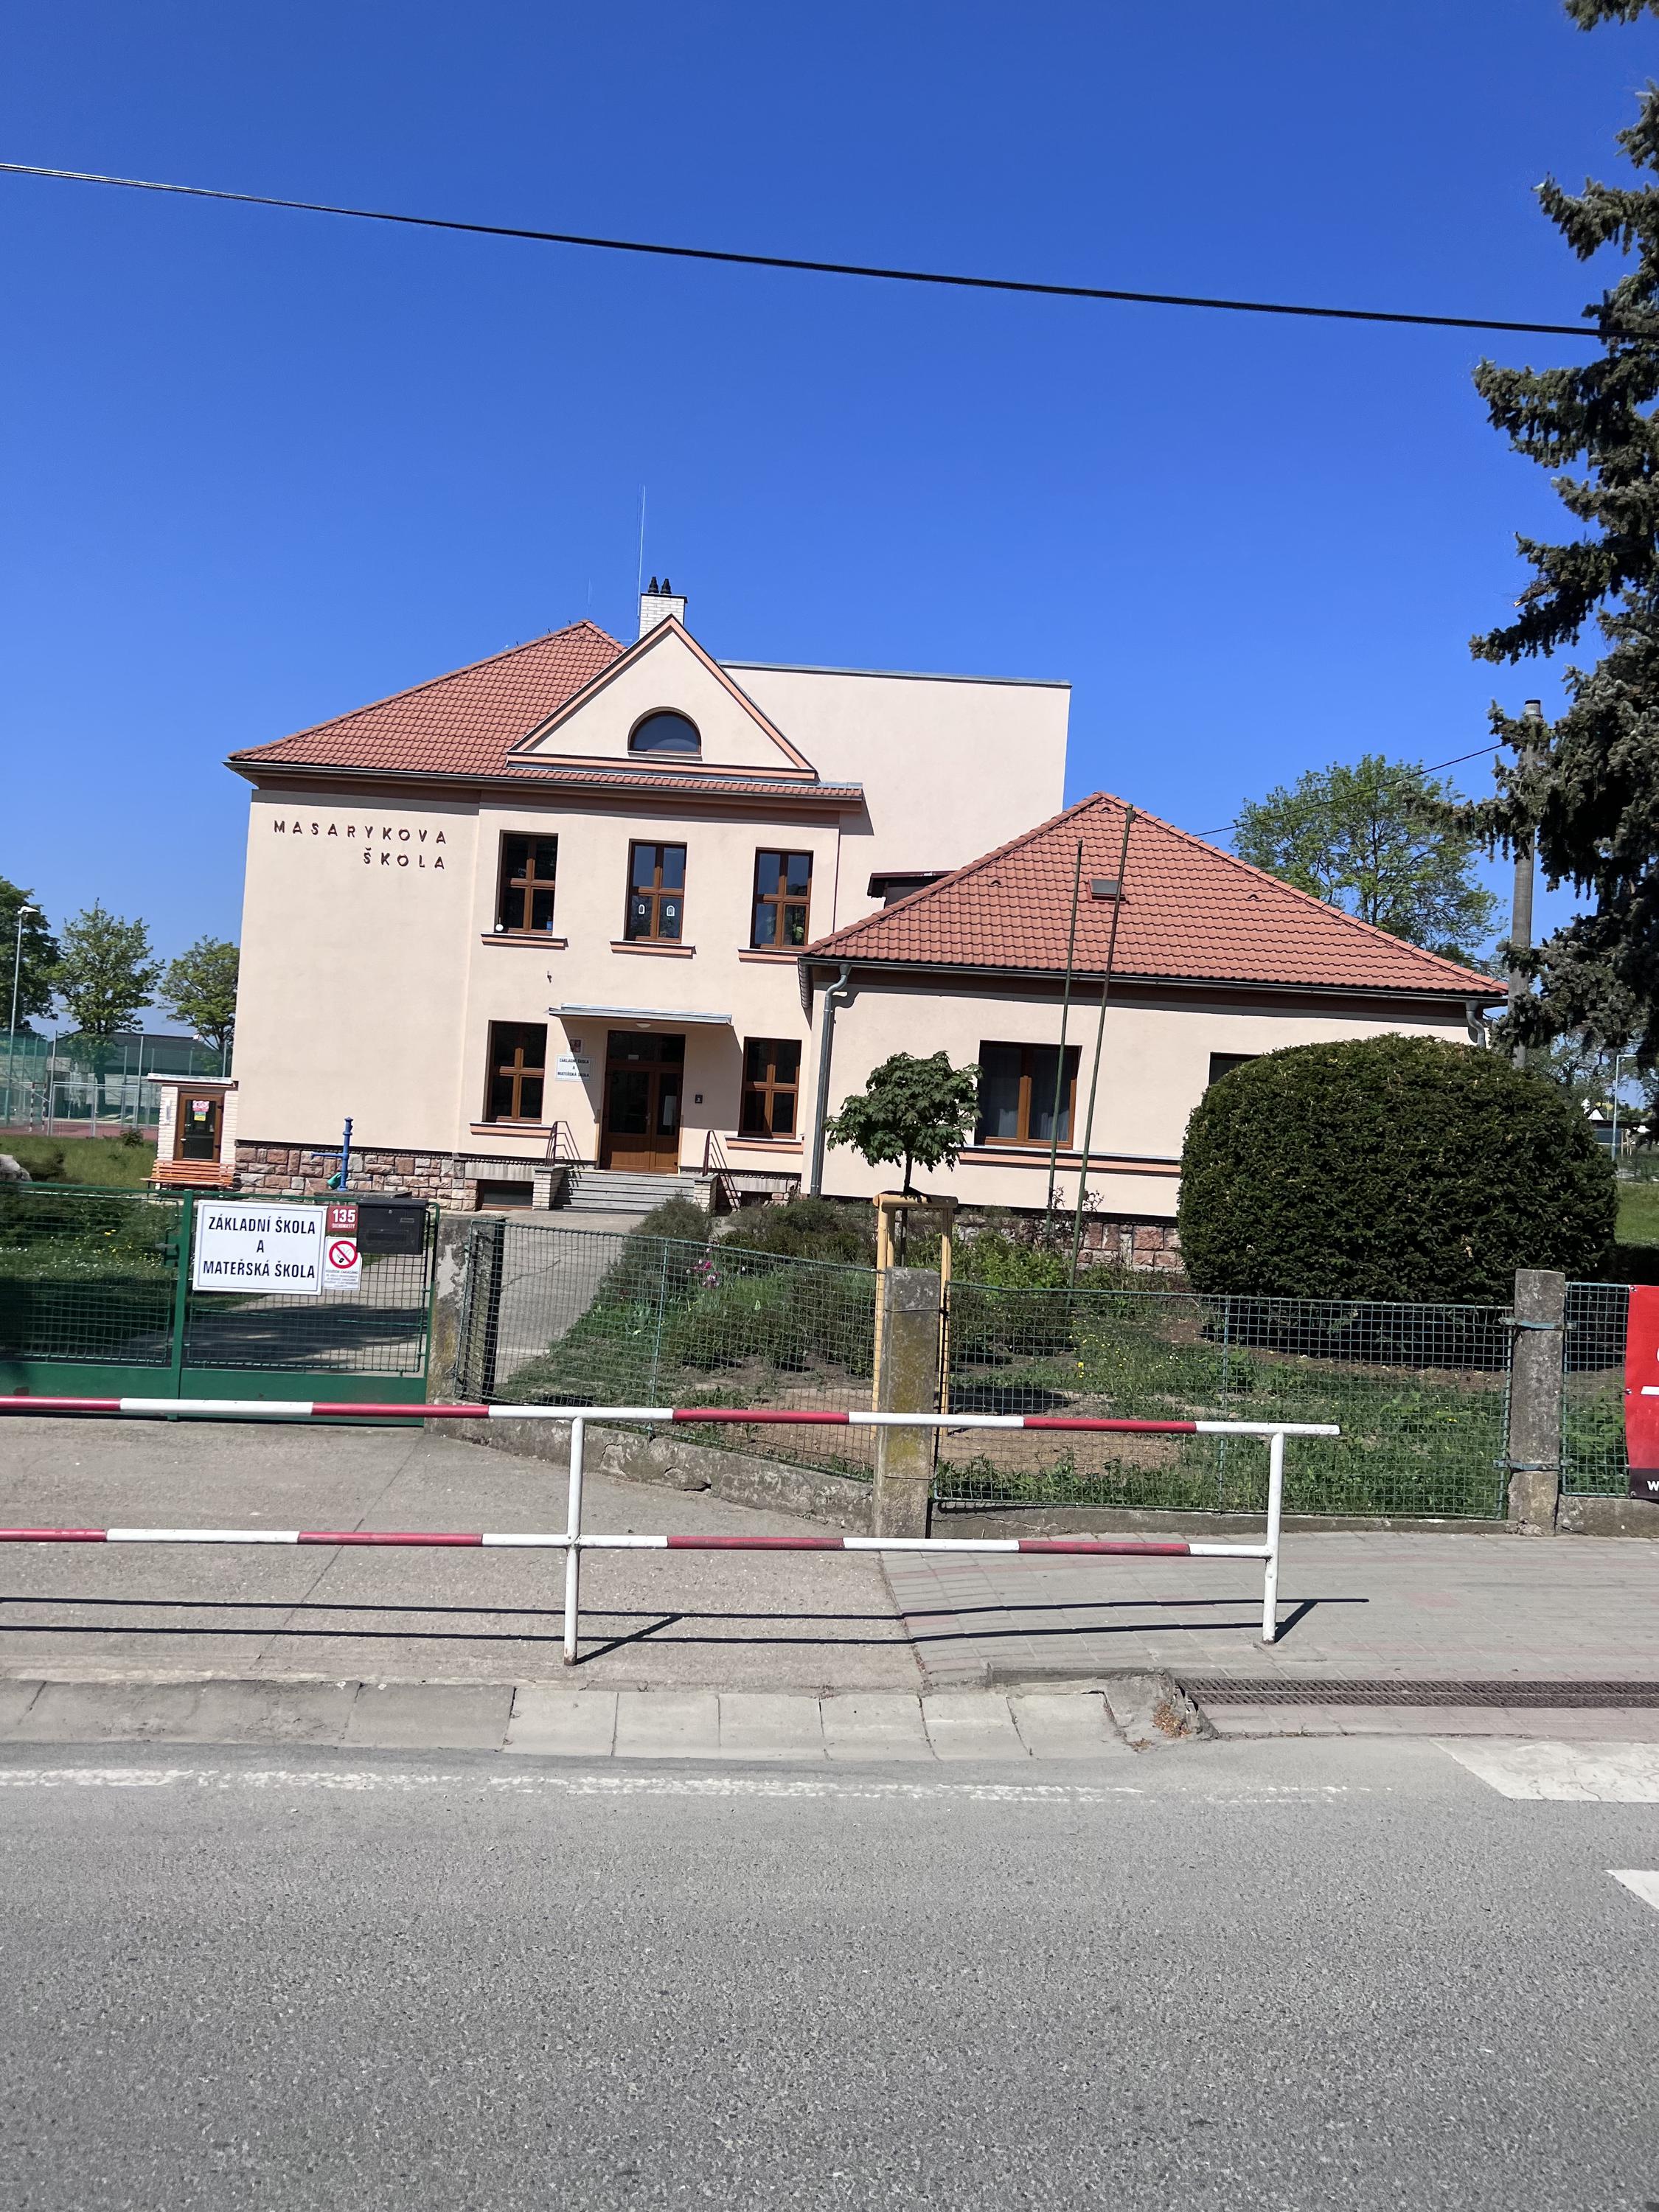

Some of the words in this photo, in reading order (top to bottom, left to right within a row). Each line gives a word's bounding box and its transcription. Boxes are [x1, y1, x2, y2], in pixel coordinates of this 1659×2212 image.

[274, 820, 446, 844] MASARYKOVA
[363, 847, 445, 869] ŠKOLA
[209, 1214, 271, 1232] ZÁKLADNÍ
[275, 1216, 316, 1234] ŠKOLA
[333, 1208, 355, 1222] 135
[256, 1239, 264, 1253] A
[203, 1259, 270, 1276] MATEŘSKÁ
[274, 1260, 315, 1279] ŠKOLA
